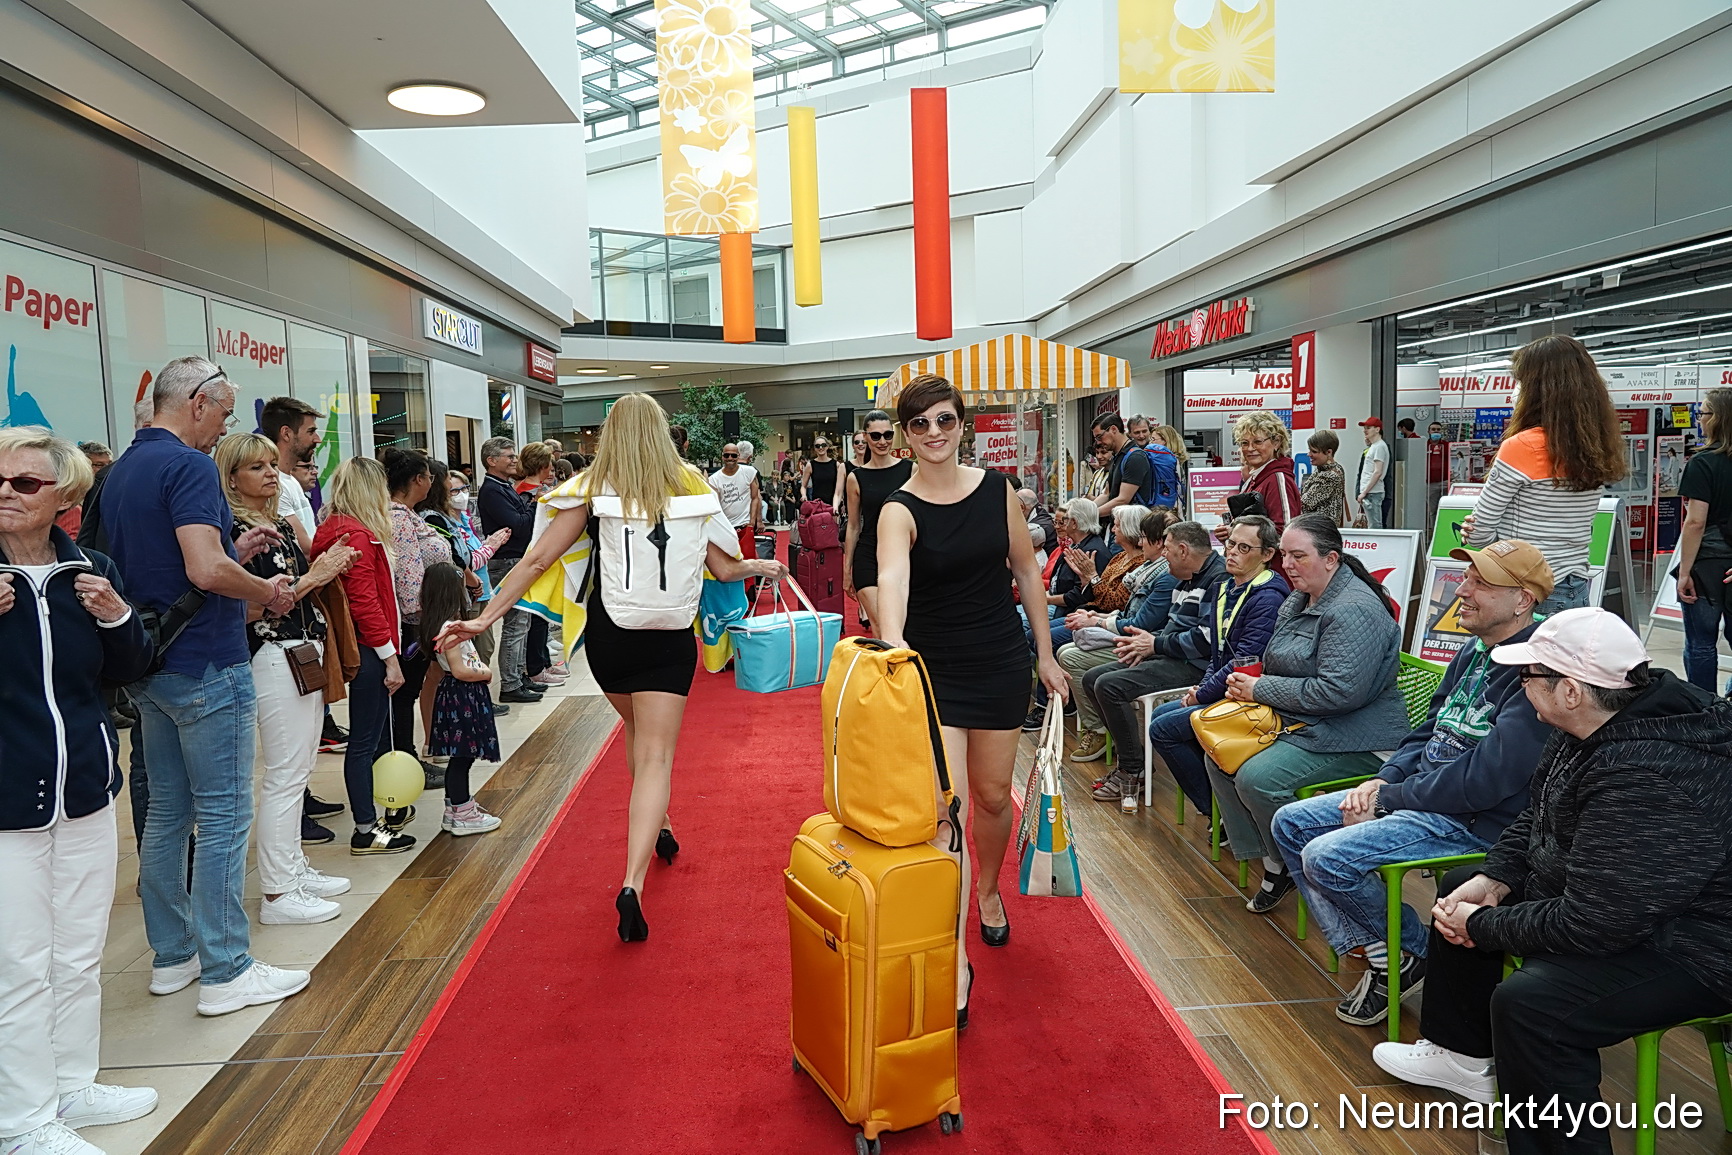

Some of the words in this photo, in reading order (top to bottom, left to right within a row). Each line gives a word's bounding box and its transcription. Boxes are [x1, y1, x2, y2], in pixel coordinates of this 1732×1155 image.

[0, 274, 94, 329] Paper
[216, 327, 286, 368] McPaper
[1298, 341, 1309, 388] 1
[1440, 377, 1481, 391] MUSIK
[1187, 397, 1264, 408] Online-Abholung
[1642, 393, 1660, 401] Ultra
[1424, 640, 1439, 649] DER
